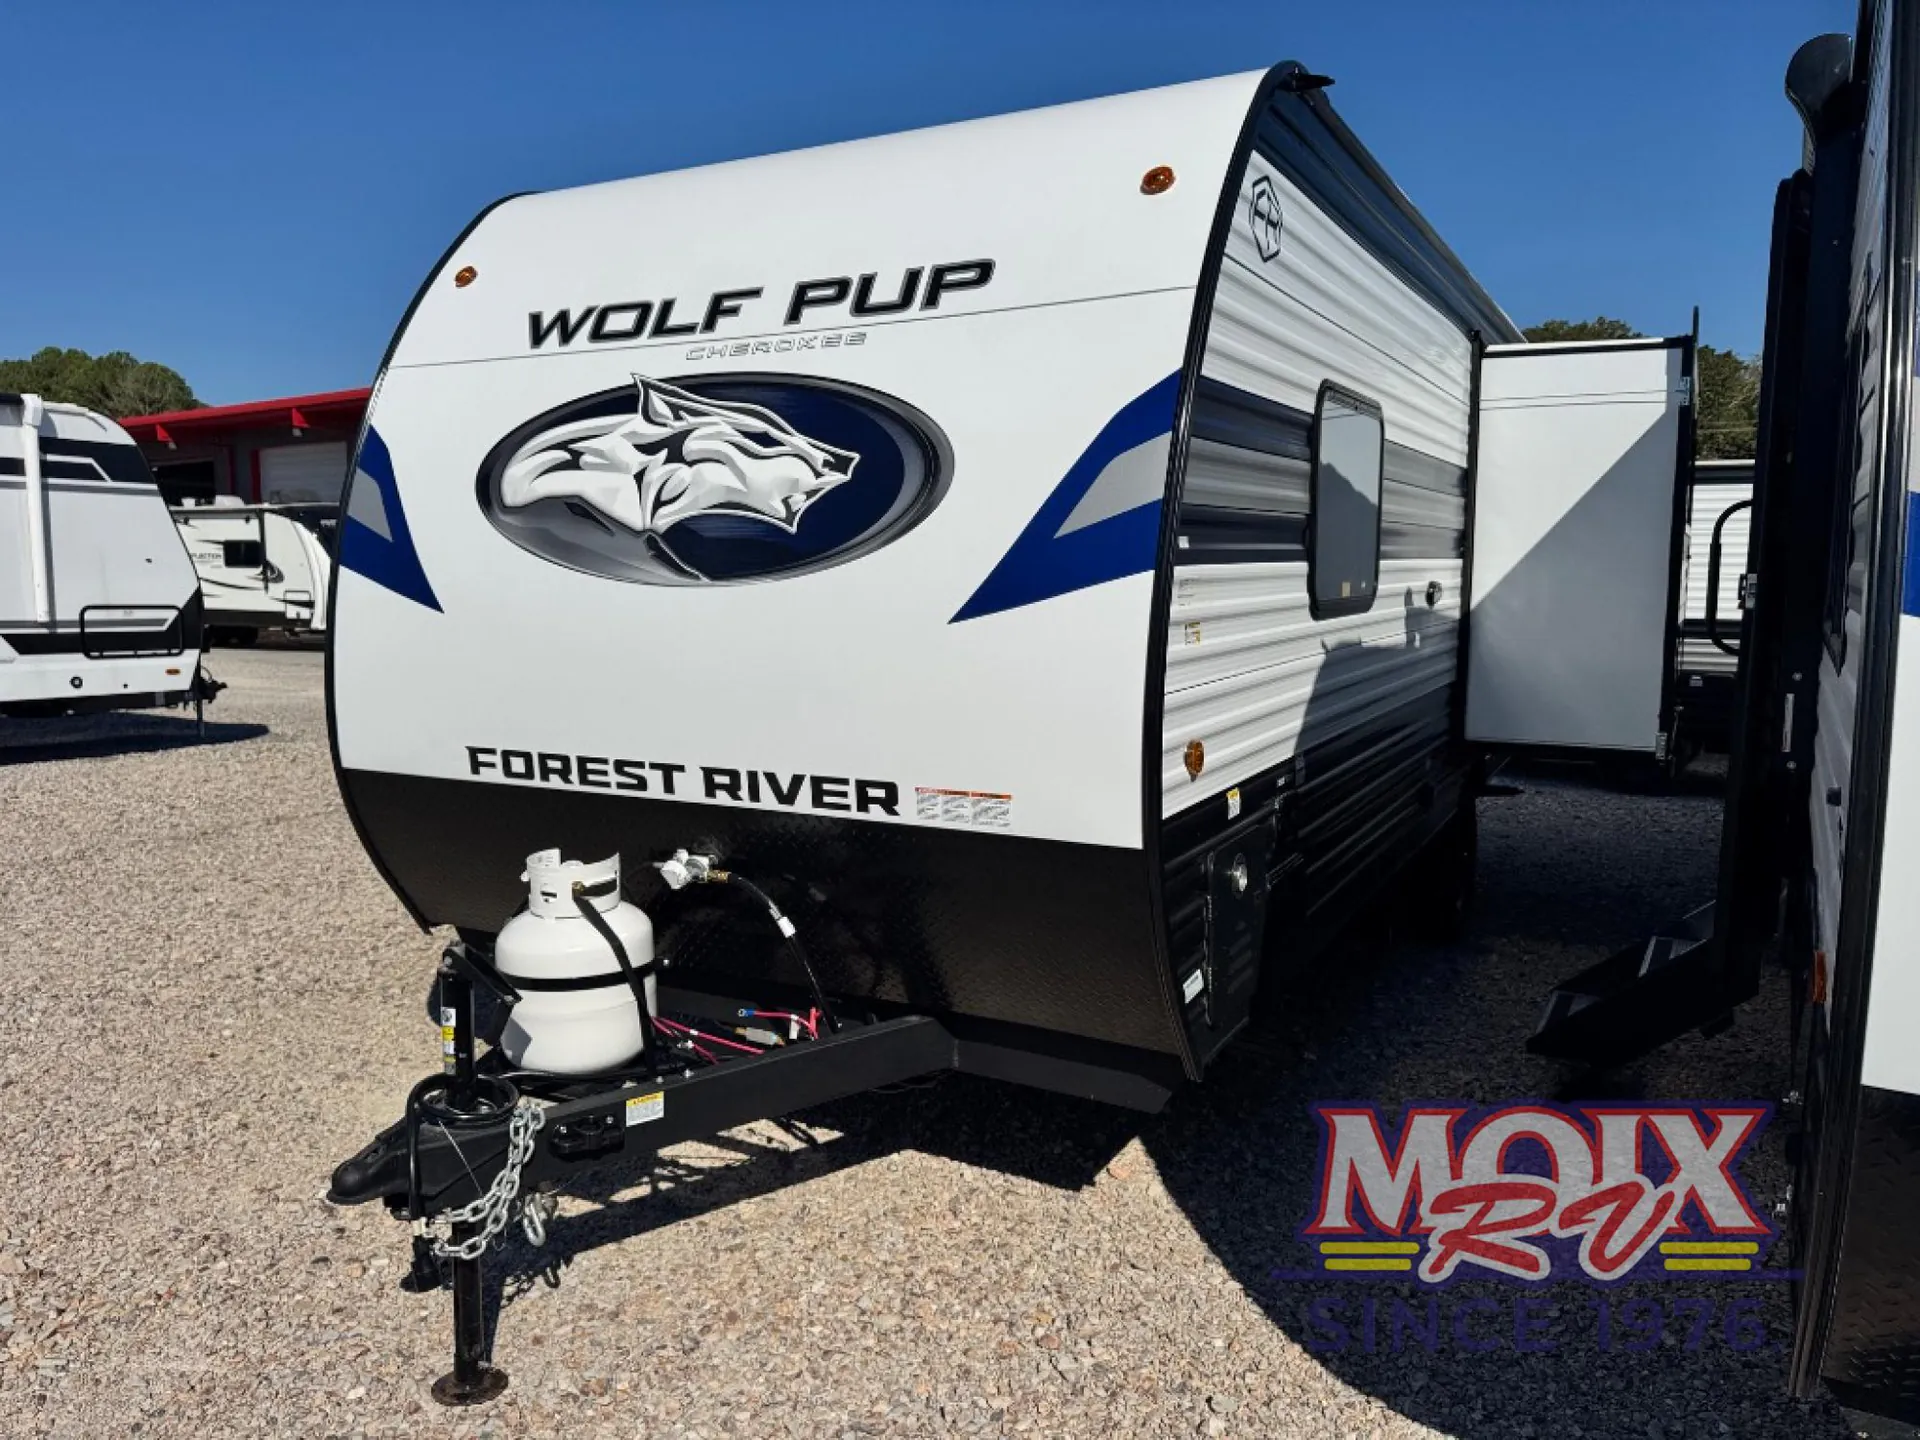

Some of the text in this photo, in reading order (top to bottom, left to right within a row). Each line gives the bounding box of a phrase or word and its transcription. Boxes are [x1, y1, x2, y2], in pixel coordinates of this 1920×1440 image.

[528, 258, 996, 350] WOLF PUP
[686, 332, 867, 361] CHEROKEE
[465, 746, 686, 795] FOREST
[700, 766, 900, 816] RIVER
